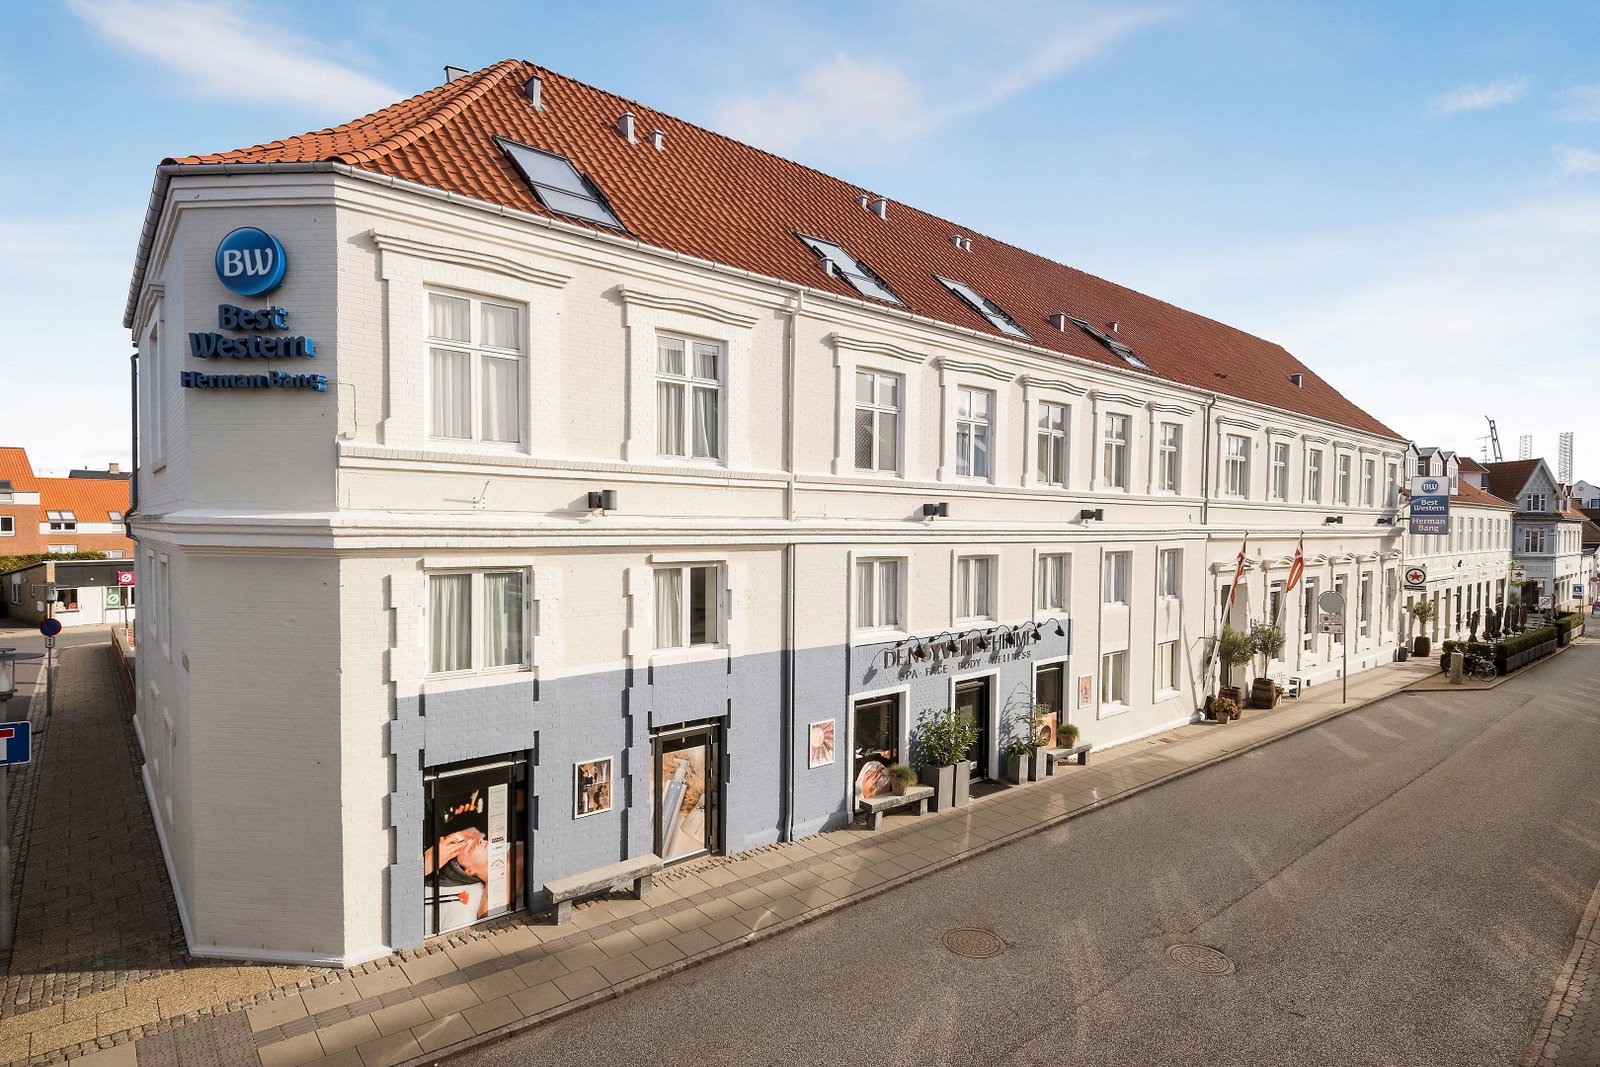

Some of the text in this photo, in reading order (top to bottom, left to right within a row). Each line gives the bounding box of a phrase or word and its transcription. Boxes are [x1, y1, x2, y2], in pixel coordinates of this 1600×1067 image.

[223, 247, 274, 278] BW
[218, 303, 288, 331] Best
[188, 332, 315, 358] Western
[181, 371, 327, 392] Herman Bang
[1422, 483, 1438, 491] BW
[1418, 525, 1440, 533] Bang
[899, 668, 918, 682] SPA
[925, 664, 948, 677] FACE
[957, 657, 981, 671] BODY
